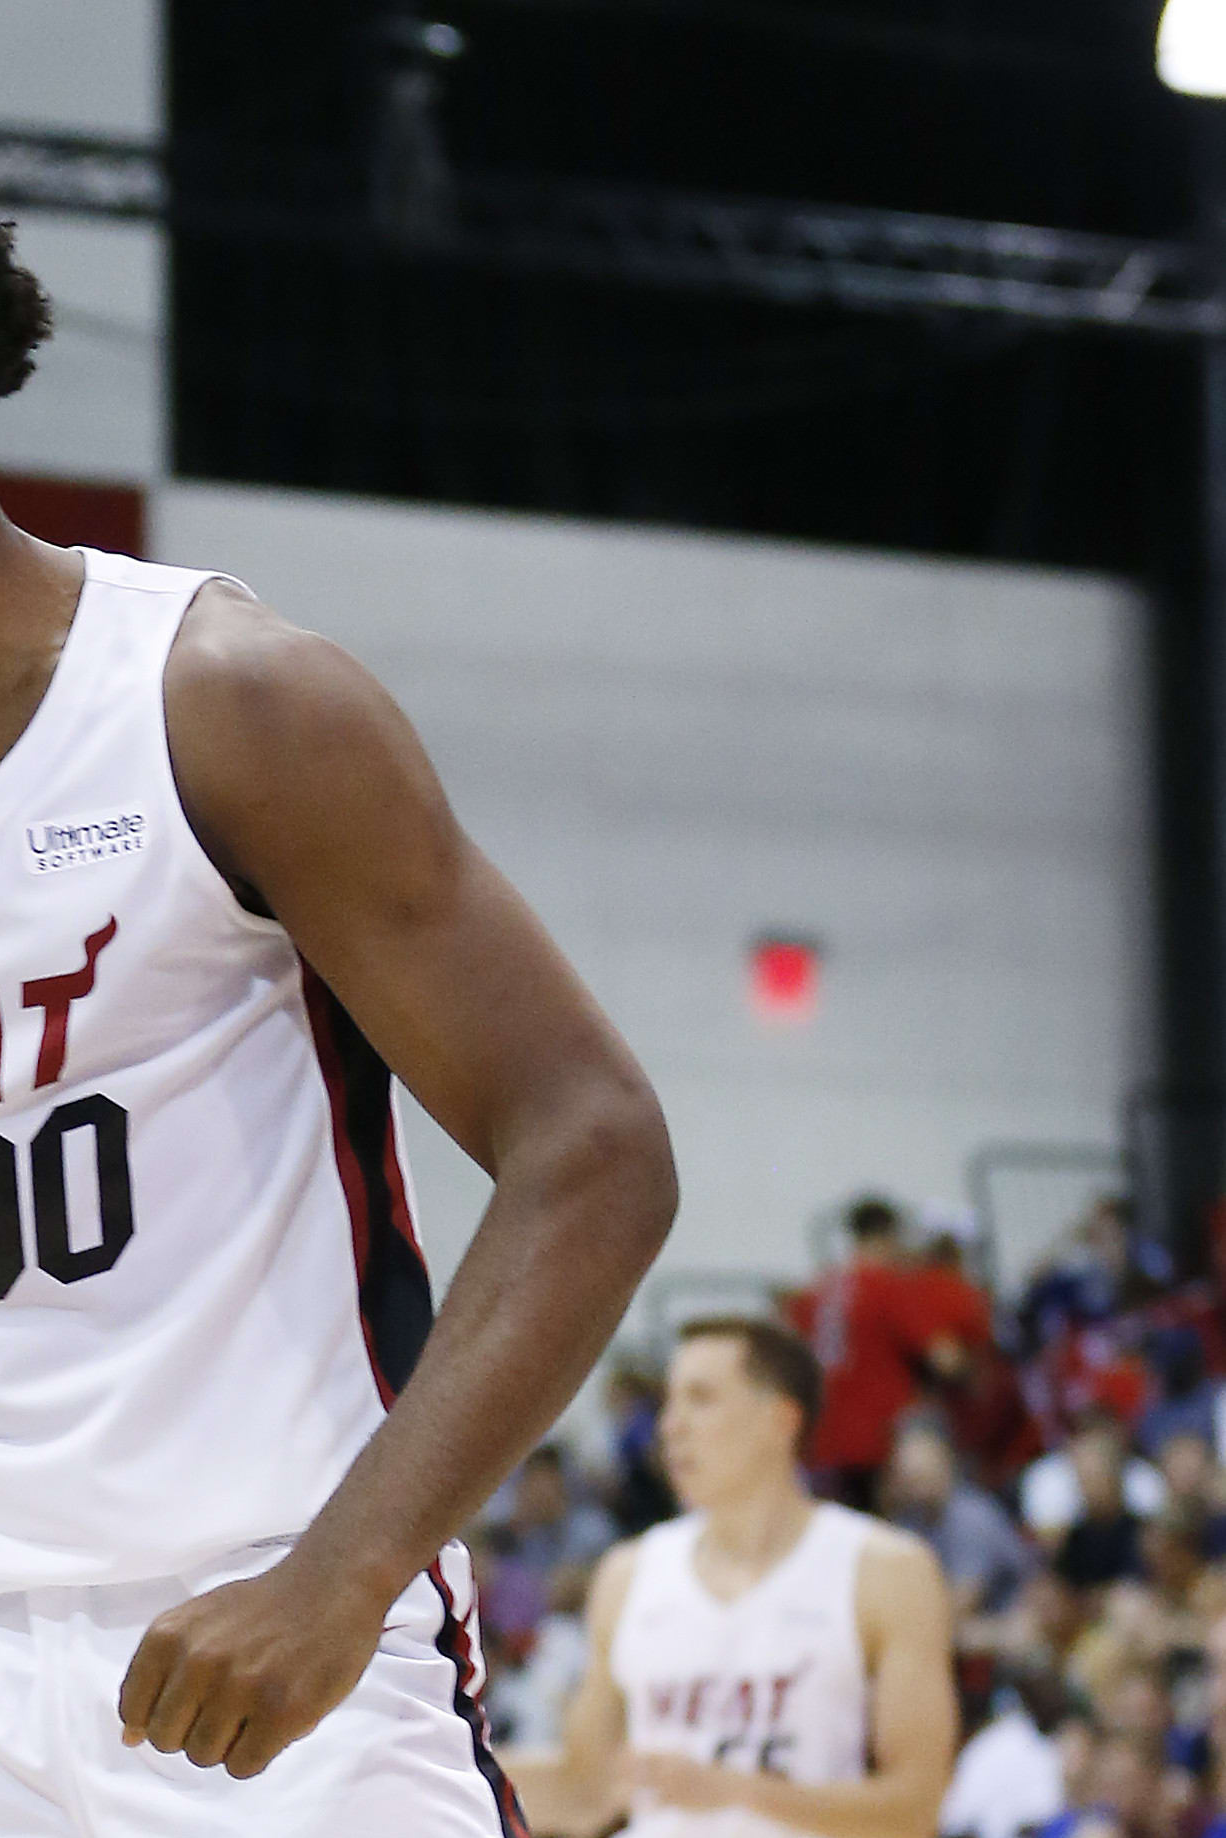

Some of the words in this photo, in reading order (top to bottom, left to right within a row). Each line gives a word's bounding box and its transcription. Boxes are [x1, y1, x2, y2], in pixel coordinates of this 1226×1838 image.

[26, 814, 145, 854] Ultimate
[37, 837, 144, 871] SOFTWARE
[646, 1656, 816, 1728] HEAT
